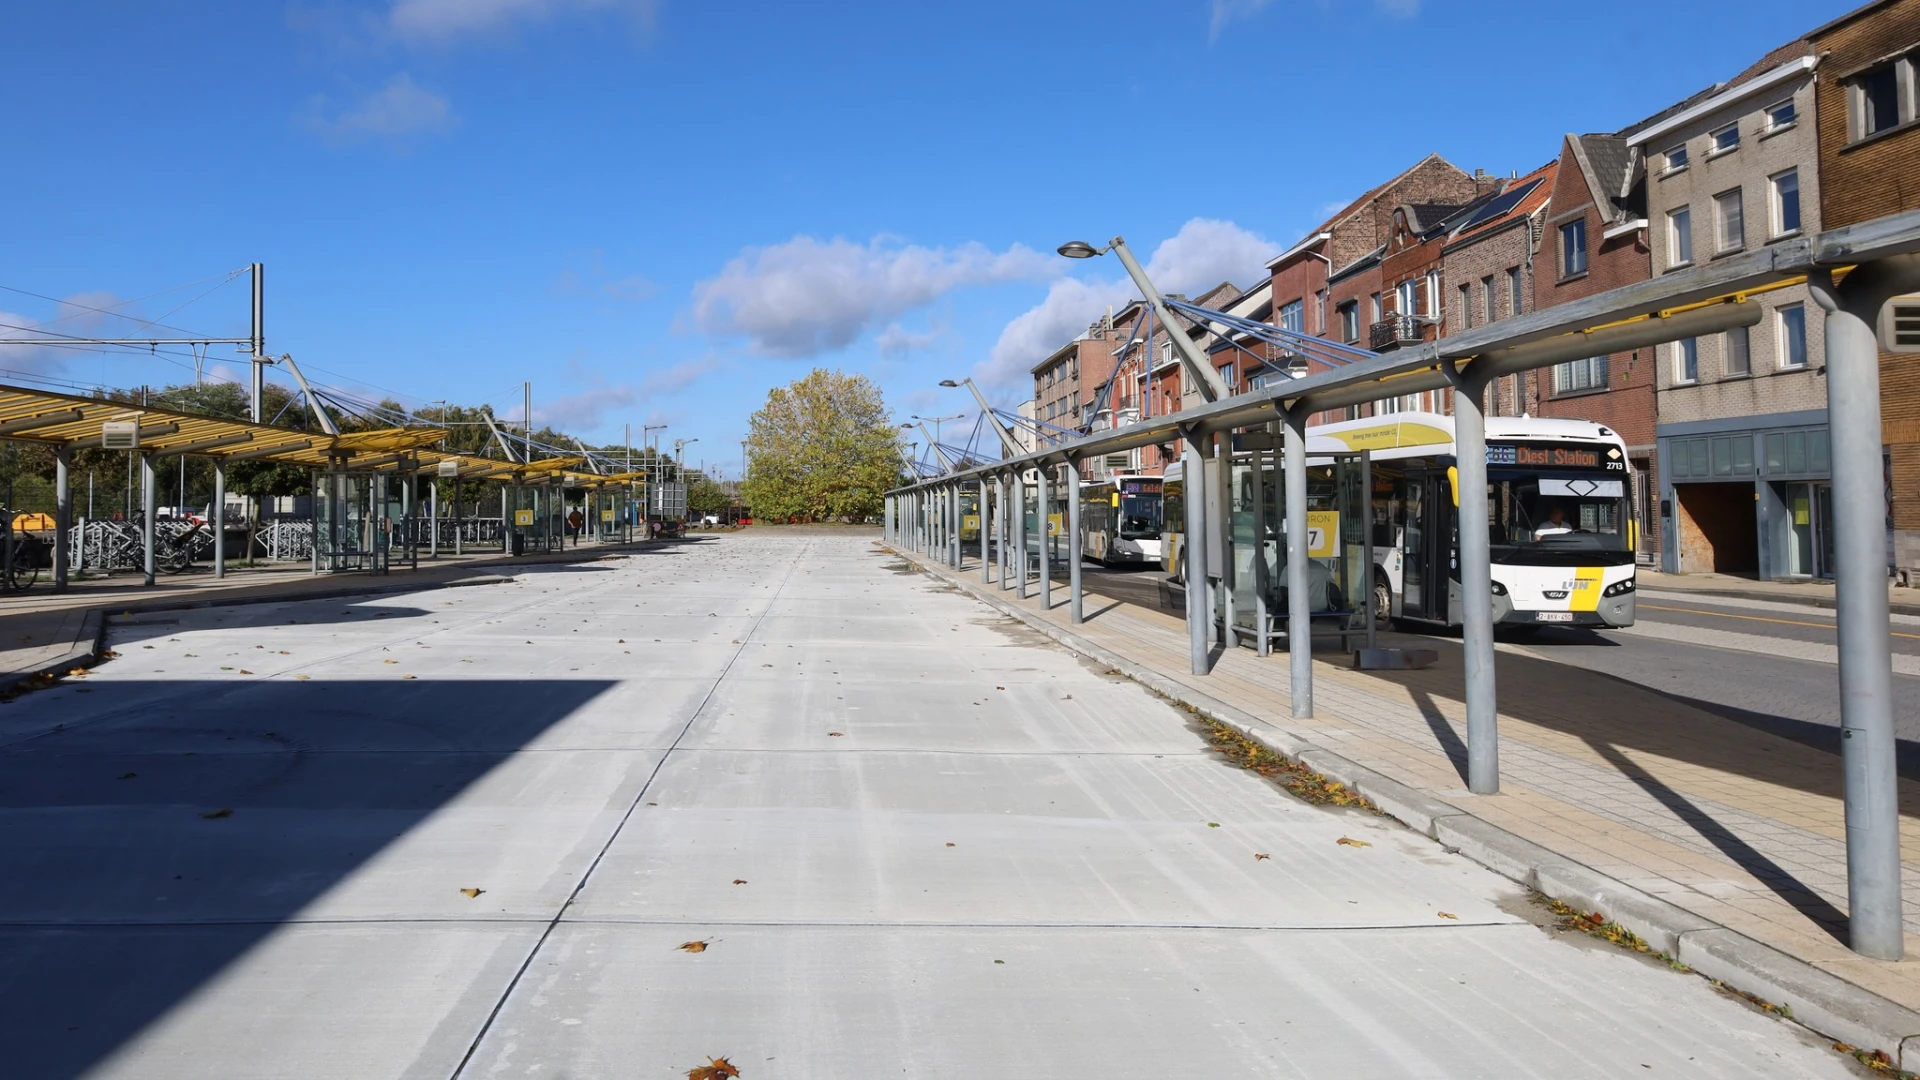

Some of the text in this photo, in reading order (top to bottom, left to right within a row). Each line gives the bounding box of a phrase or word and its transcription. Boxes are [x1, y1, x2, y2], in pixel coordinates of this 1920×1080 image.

[1518, 447, 1549, 464] Diest
[1554, 448, 1596, 466] Station
[1606, 462, 1623, 470] 2713
[1309, 531, 1318, 546] 7
[1562, 581, 1589, 590] LIJN
